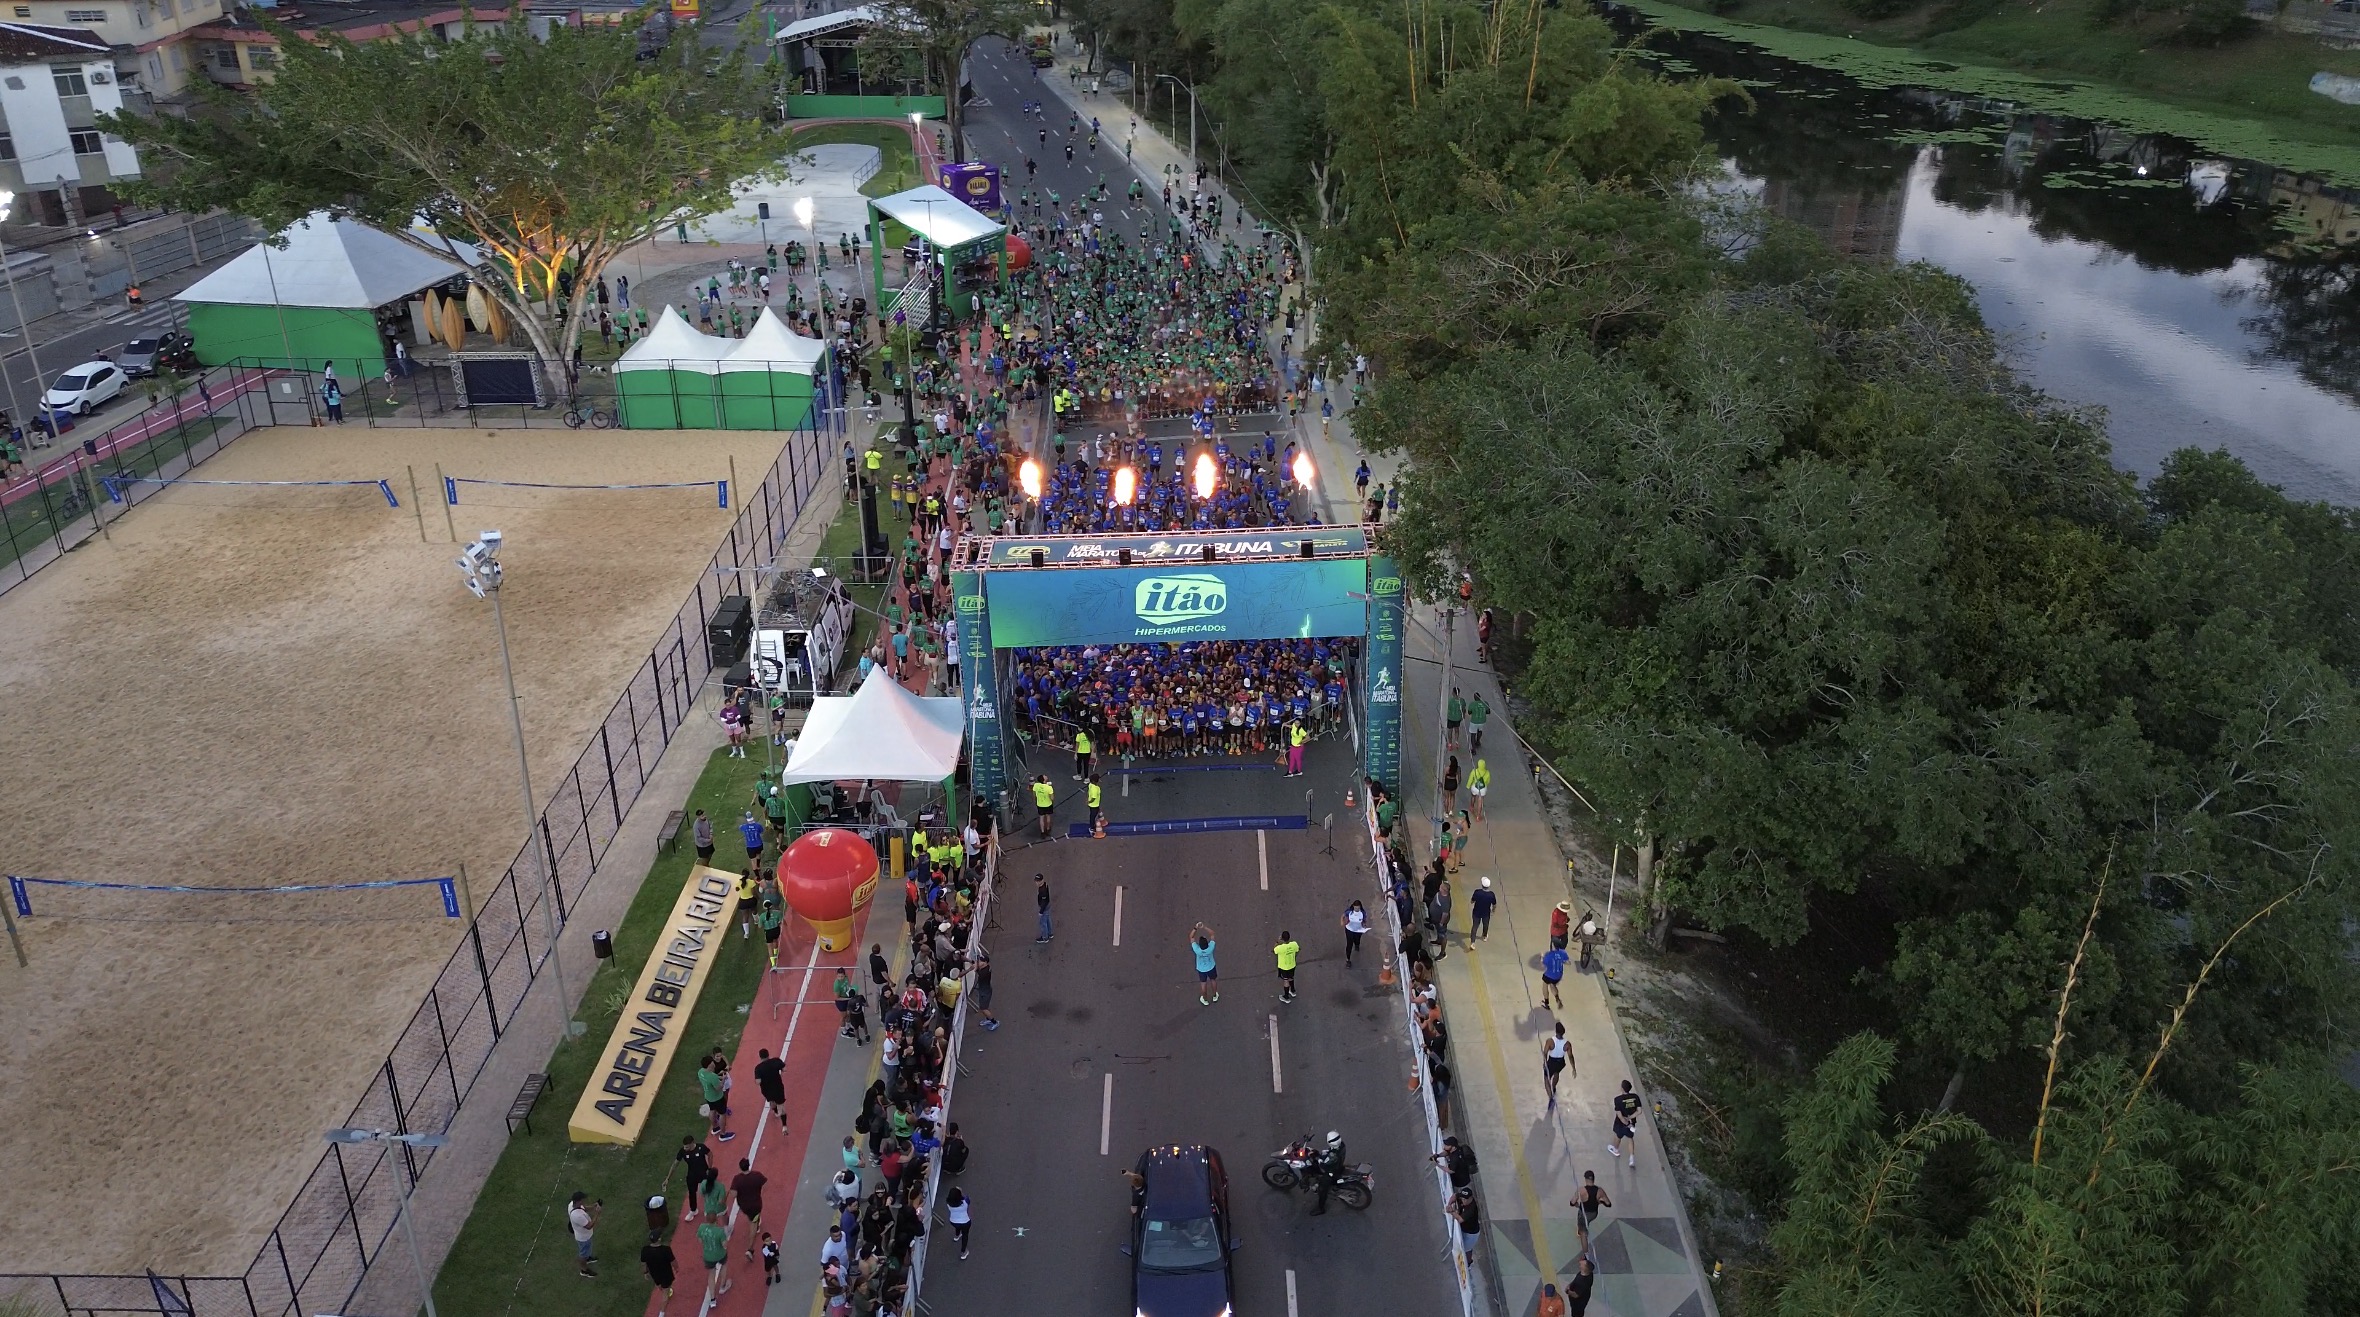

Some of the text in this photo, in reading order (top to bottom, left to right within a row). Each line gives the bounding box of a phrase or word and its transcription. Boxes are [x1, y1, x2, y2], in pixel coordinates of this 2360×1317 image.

[1067, 549, 1138, 558] MARATOA
[1376, 579, 1400, 590] itão
[1141, 582, 1225, 611] itão
[1135, 624, 1227, 636] HIPERMERCADOS
[595, 875, 731, 1126] ARENA BEIRA RIO
